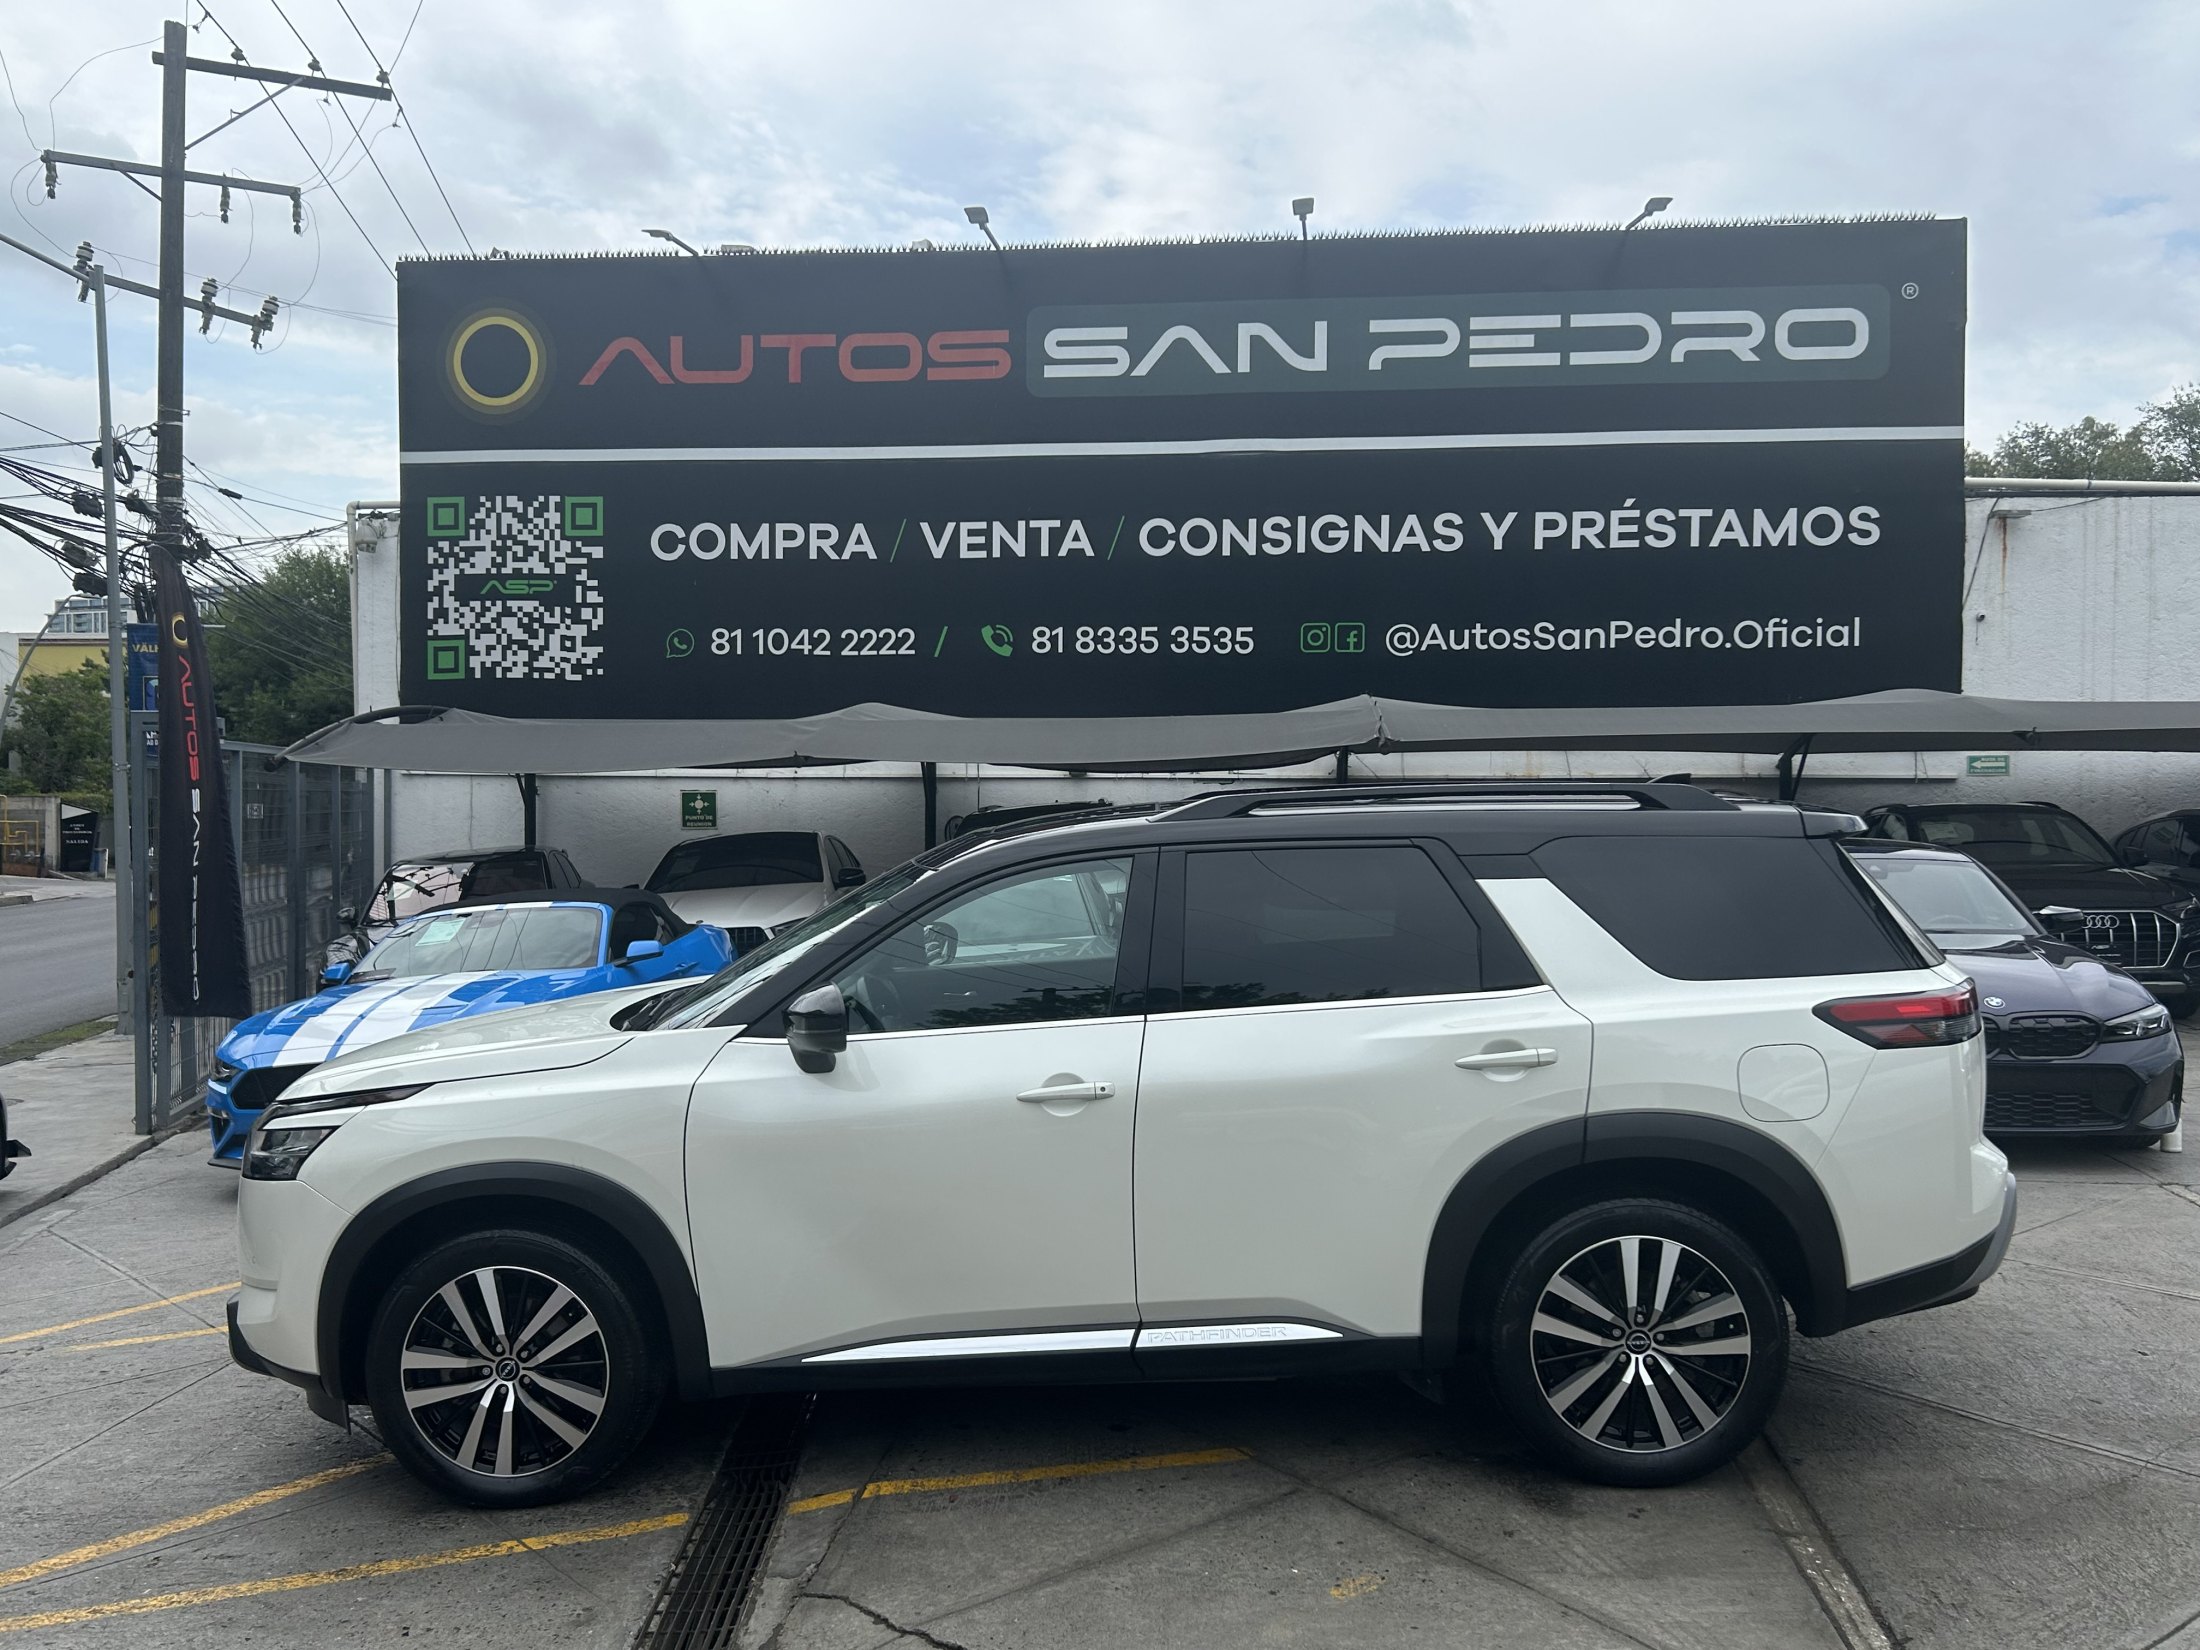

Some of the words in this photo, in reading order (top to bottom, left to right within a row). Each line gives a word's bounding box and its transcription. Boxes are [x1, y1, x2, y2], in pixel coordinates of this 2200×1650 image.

[579, 329, 1012, 386] AUTOS
[1043, 321, 1328, 377] SAN
[1368, 306, 1870, 371] PEDRO
[650, 522, 878, 562] COMPRA
[919, 519, 1095, 560] VENTA
[1138, 512, 1464, 557] CONSIGNAS
[1479, 511, 1519, 551] Y
[1533, 498, 1881, 550] PRÉSTAMOS
[480, 580, 554, 594] ASP
[710, 627, 742, 656] 81
[752, 627, 831, 656] 1042
[840, 627, 916, 657] 2222
[1031, 625, 1064, 654] 81
[1074, 625, 1159, 655] 8335
[1170, 625, 1255, 655] 3535
[1385, 617, 1861, 657] @AutosSanPedro.Oficial
[178, 655, 200, 781] AUTOS
[191, 788, 201, 867] SAN
[1147, 1326, 1288, 1343] PATHFINDER
